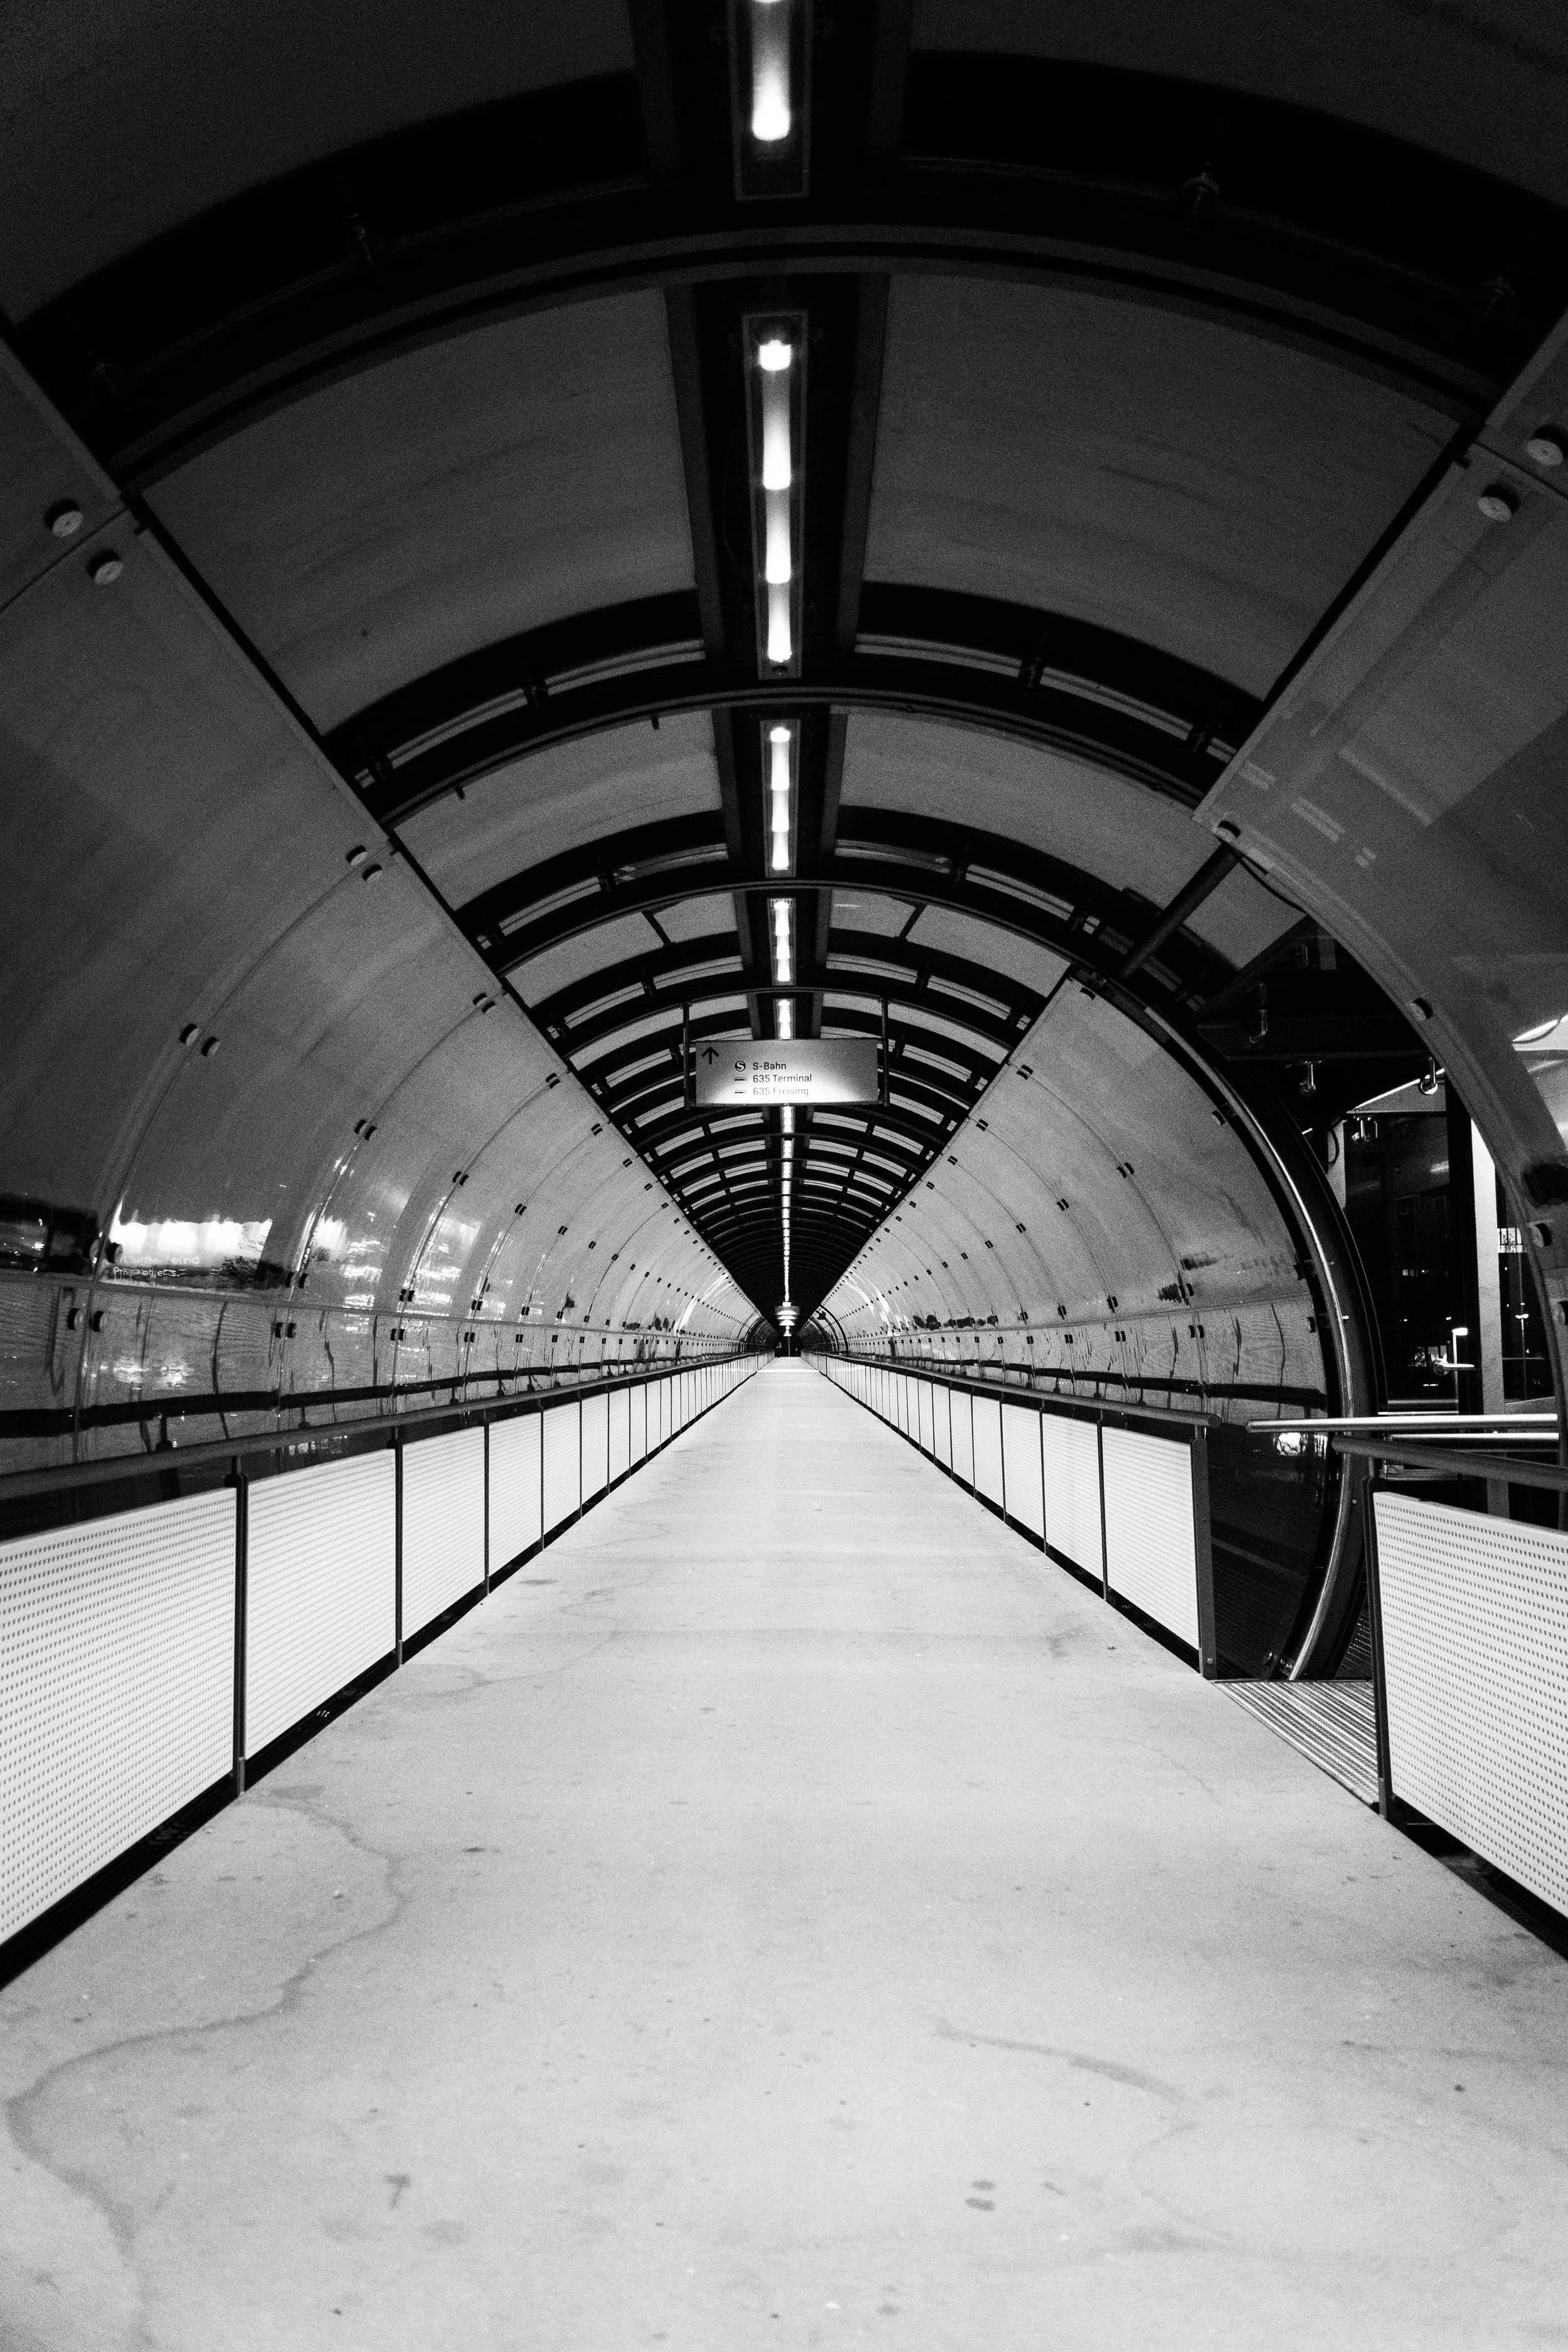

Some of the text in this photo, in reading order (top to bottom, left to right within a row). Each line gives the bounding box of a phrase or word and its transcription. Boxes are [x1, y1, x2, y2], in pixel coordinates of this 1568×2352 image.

[735, 1061, 787, 1071] S S-Bahn
[753, 1074, 812, 1083] 635 Terminal
[753, 1087, 809, 1096] 635 Freising
